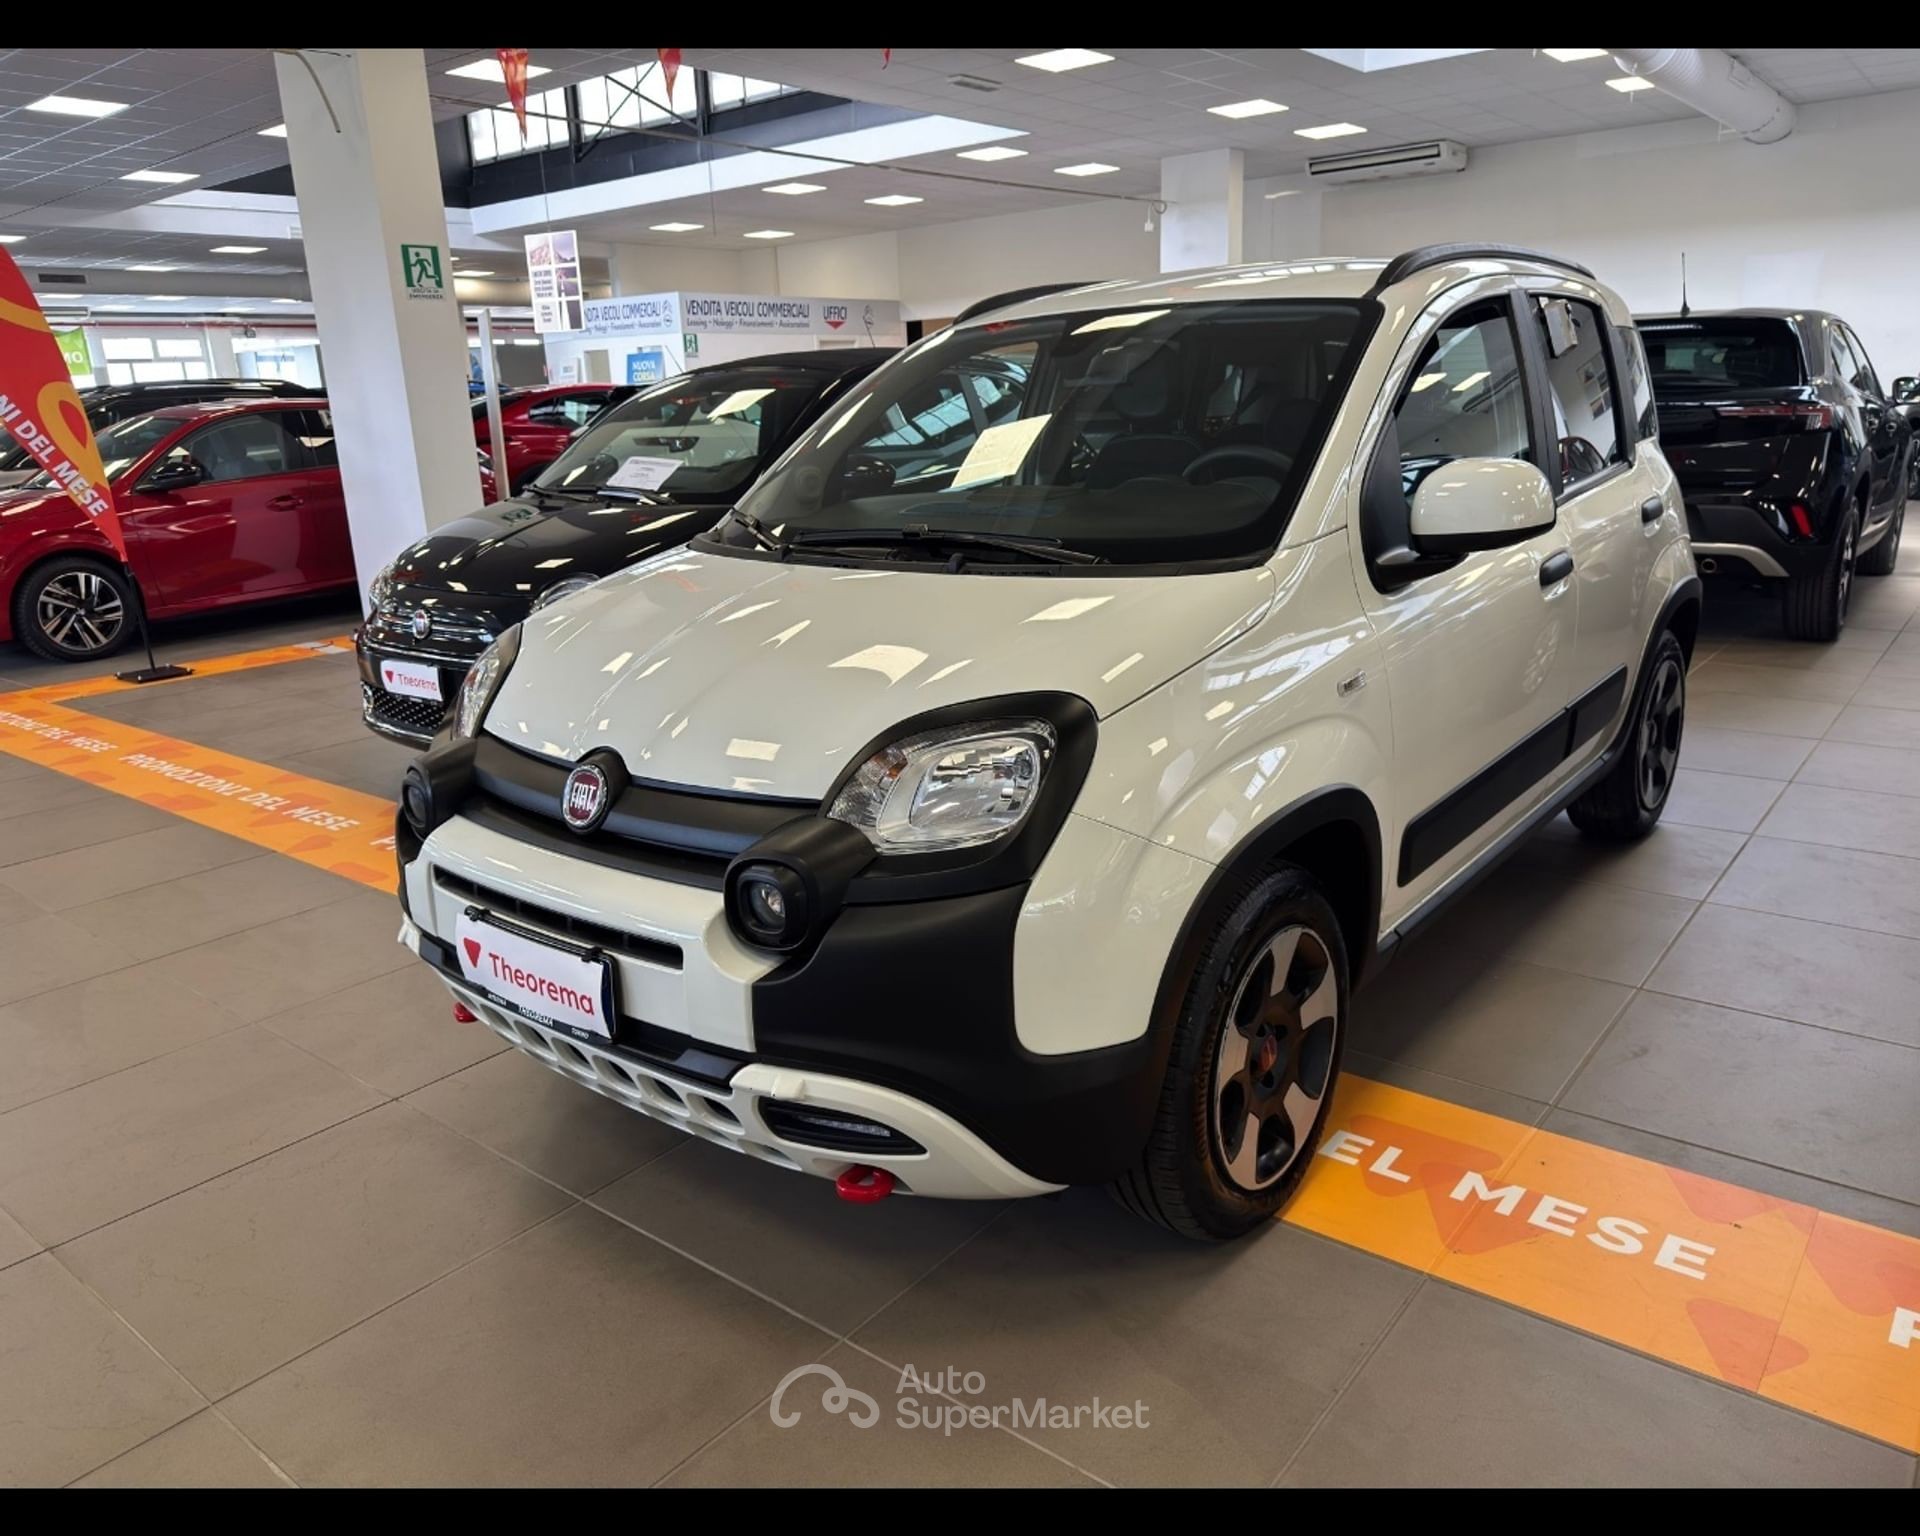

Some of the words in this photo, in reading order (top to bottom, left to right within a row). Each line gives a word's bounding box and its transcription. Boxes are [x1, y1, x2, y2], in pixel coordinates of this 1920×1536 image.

[686, 300, 722, 316] VENDITA
[725, 301, 754, 317] VEICOLI
[757, 302, 810, 318] COMMERCIALI
[823, 305, 847, 320] UFFICI
[632, 359, 655, 371] NUOVA
[14, 419, 56, 463] DEL
[52, 460, 109, 517] MESE
[119, 753, 252, 796] PROMOZIONI
[238, 791, 291, 811] DEL
[281, 805, 361, 831] MESE
[570, 781, 597, 811] FIAT
[488, 952, 596, 1016] Theorema
[1318, 1129, 1412, 1184] EL
[1448, 1170, 1717, 1281] MESE
